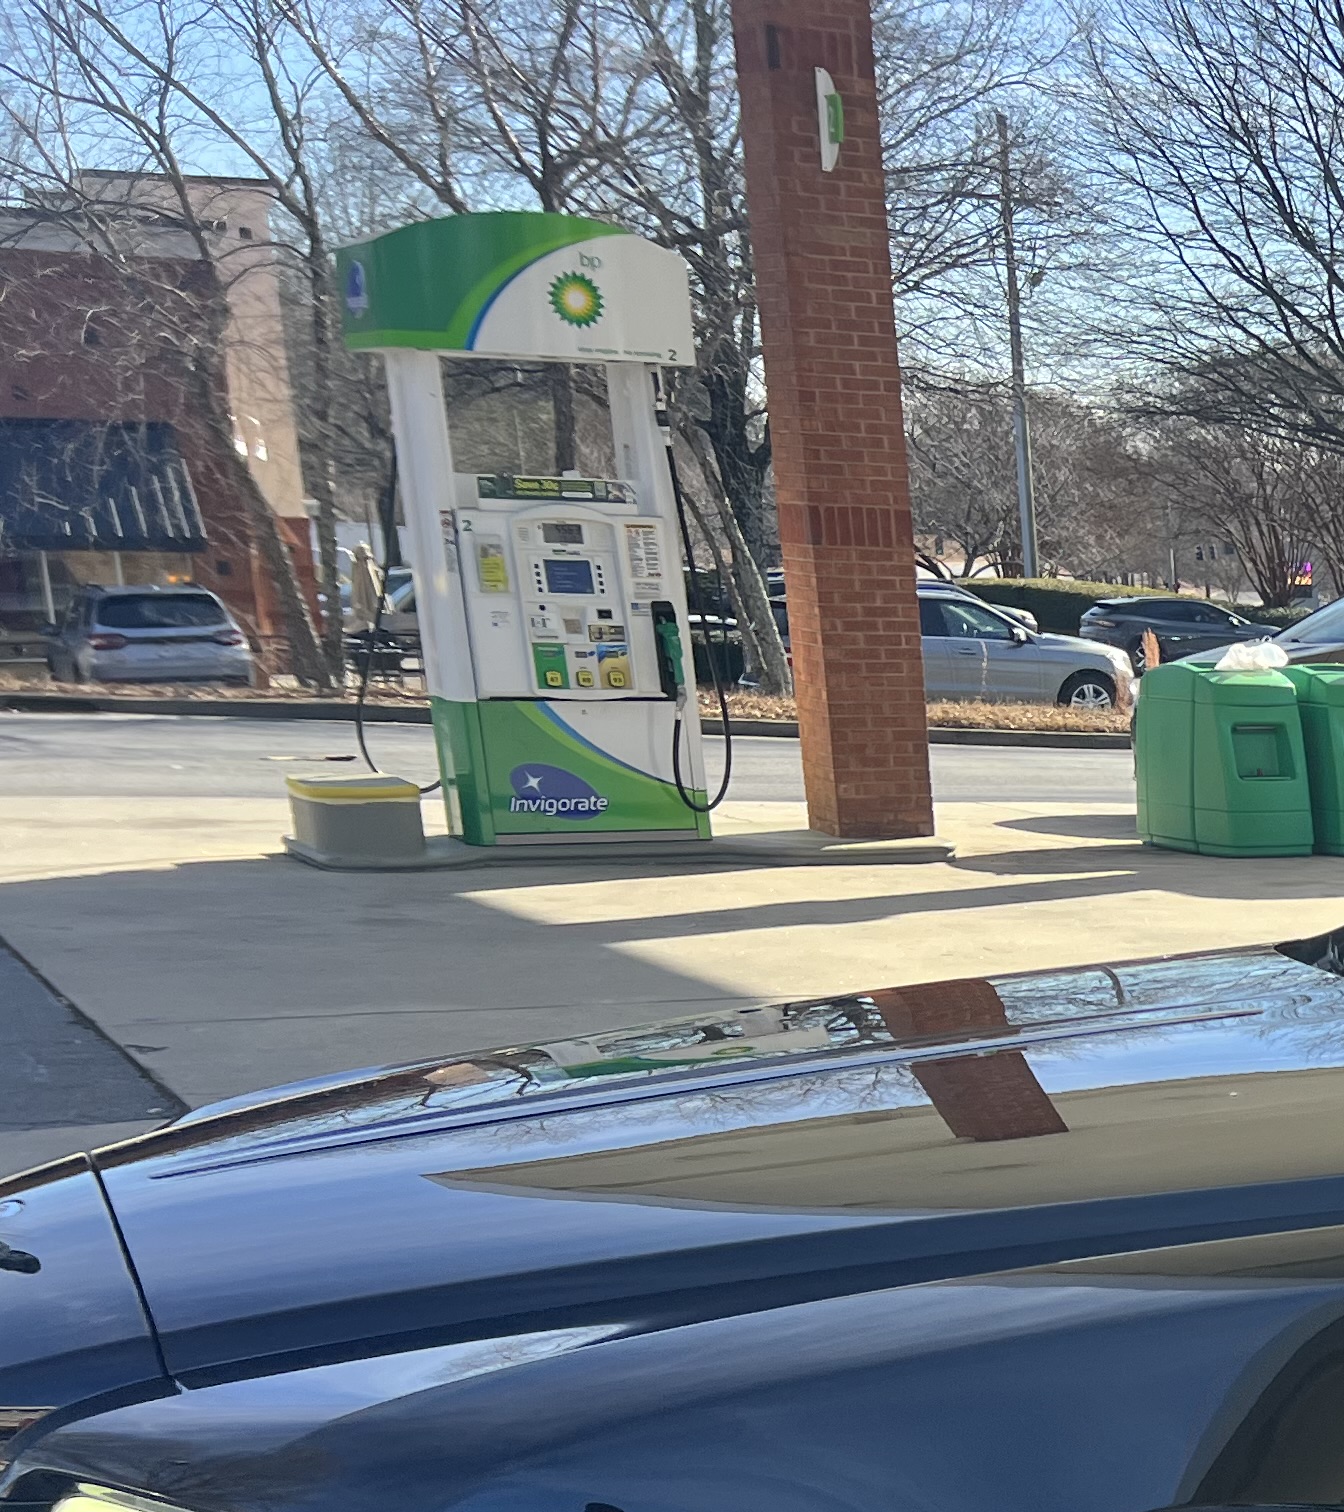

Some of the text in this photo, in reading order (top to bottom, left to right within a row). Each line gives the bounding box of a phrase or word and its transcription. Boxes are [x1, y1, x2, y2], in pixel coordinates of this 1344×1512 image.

[579, 251, 602, 271] bp
[667, 349, 677, 361] 2
[462, 519, 473, 532] 2
[510, 795, 608, 816] Invigorate
